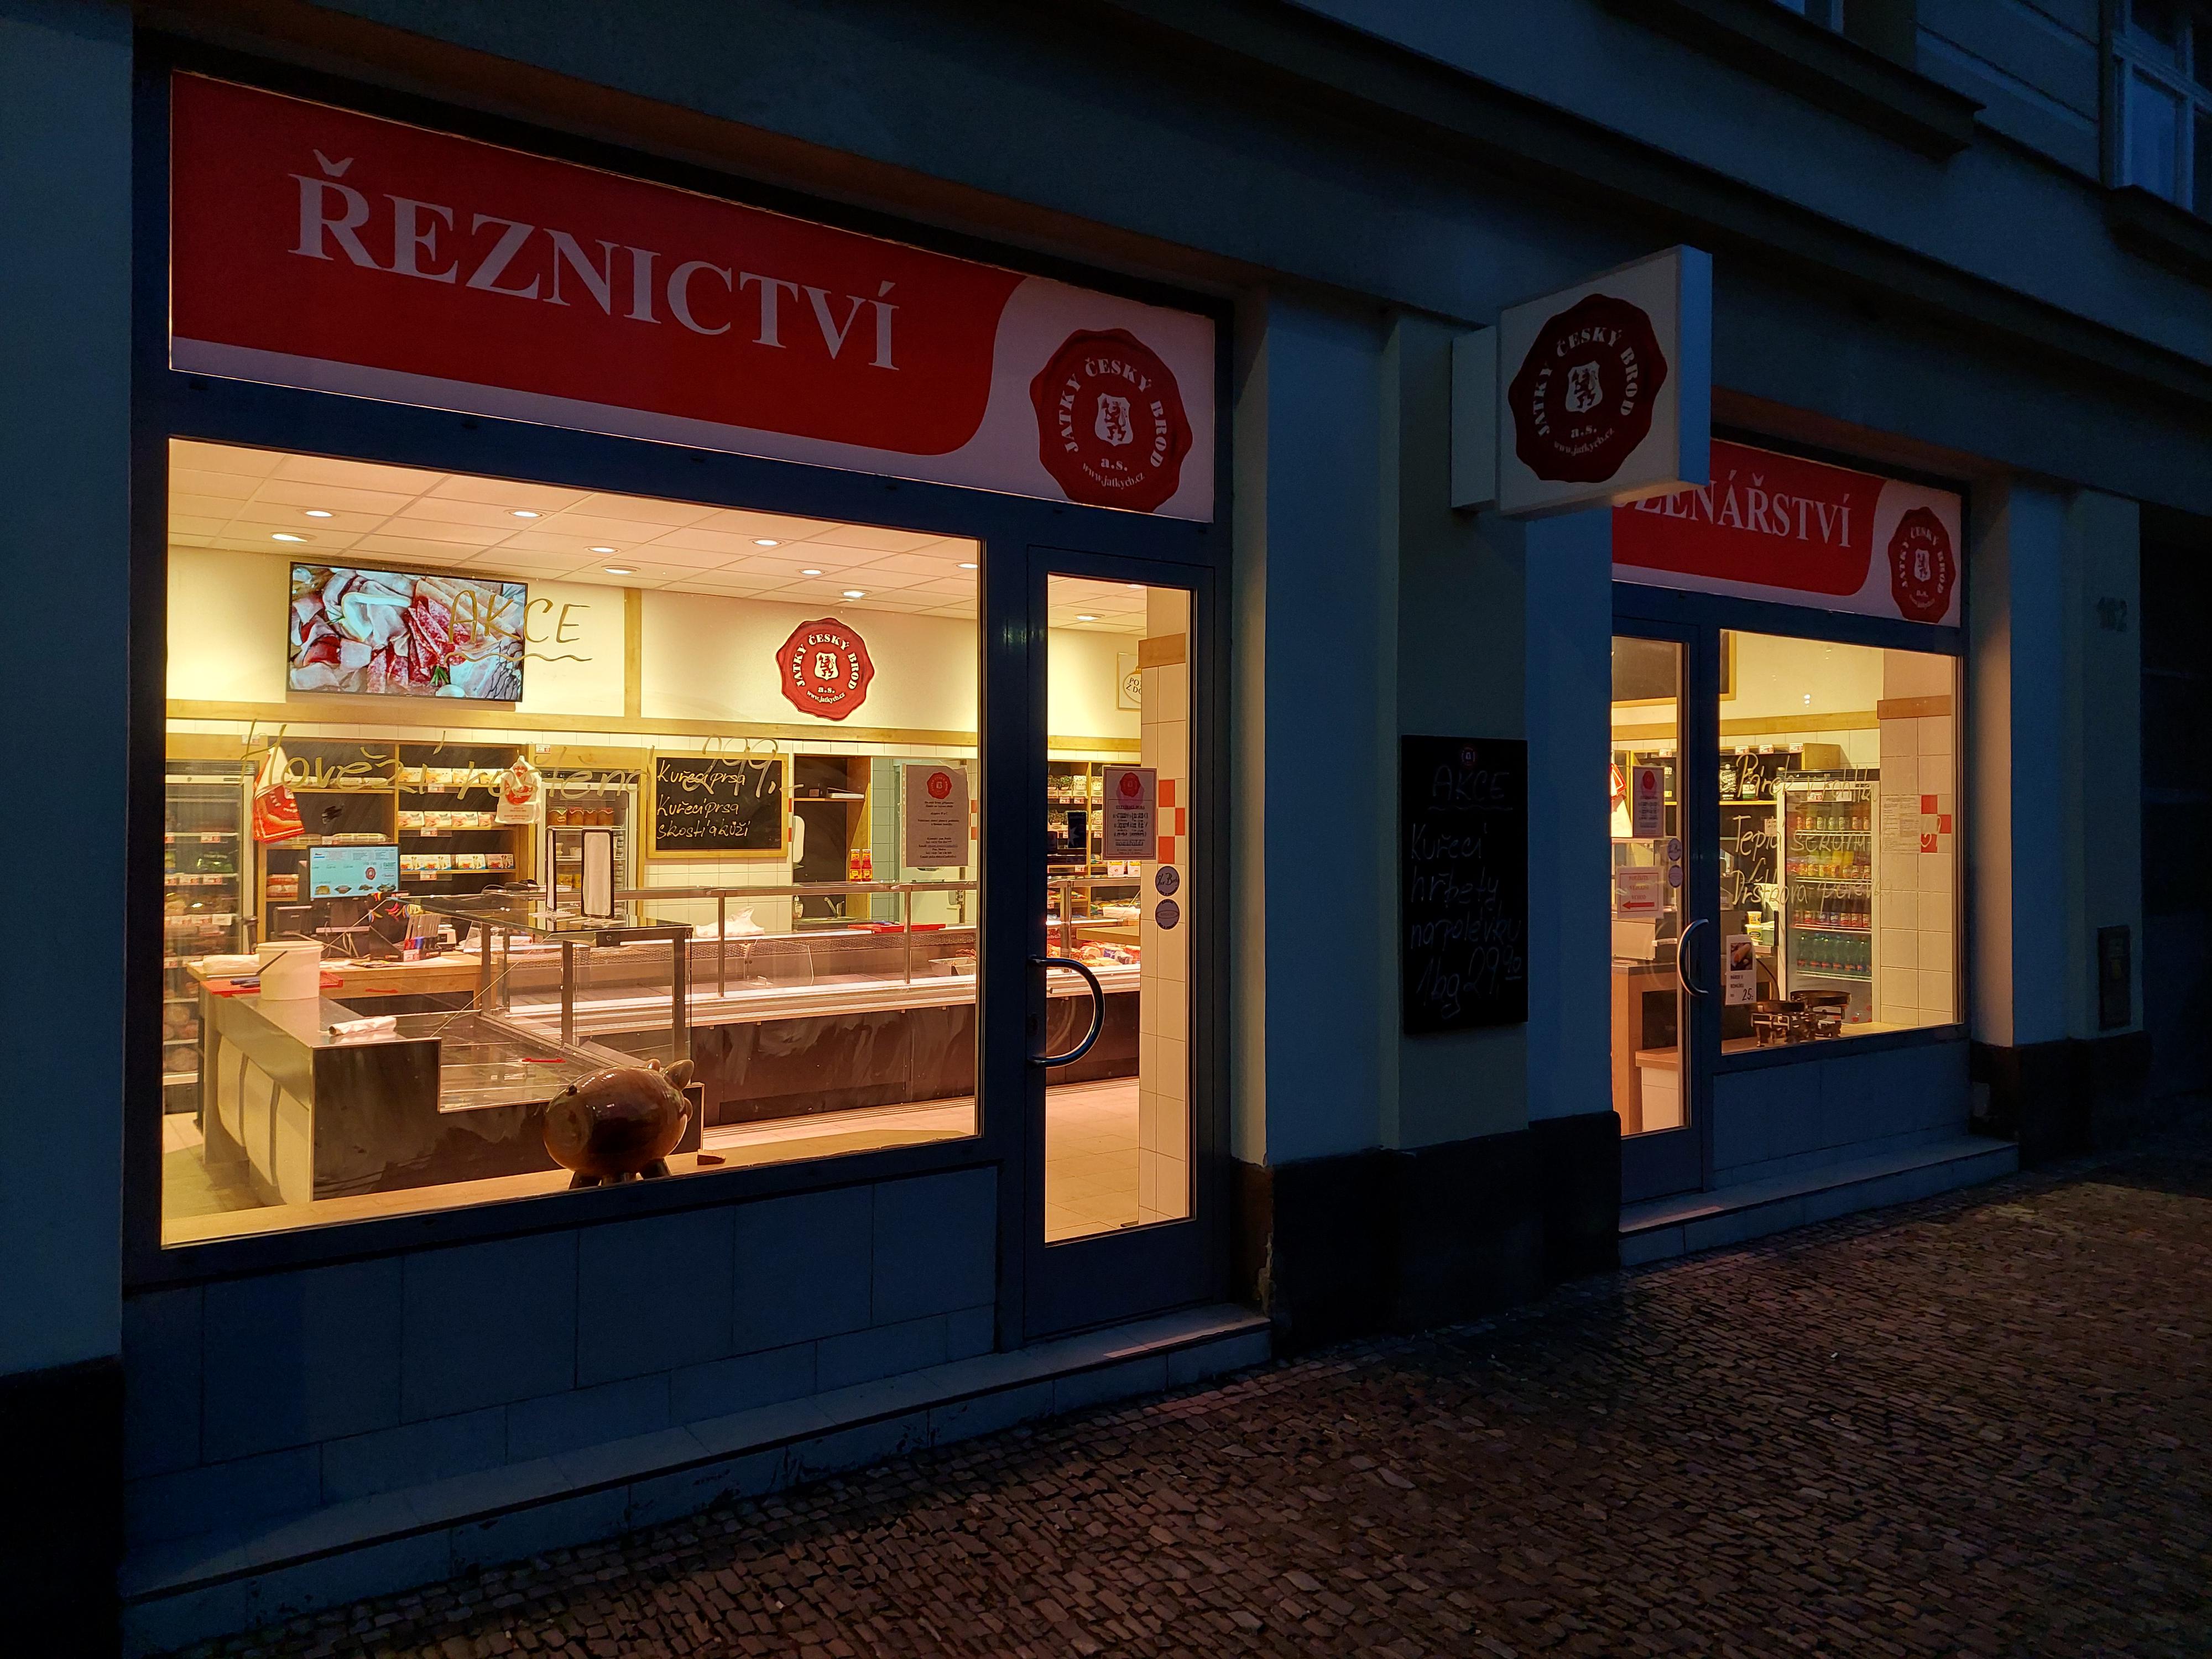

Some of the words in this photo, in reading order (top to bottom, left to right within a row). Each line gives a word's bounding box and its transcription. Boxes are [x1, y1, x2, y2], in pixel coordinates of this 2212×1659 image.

[288, 149, 900, 371] ŘEZNICTVÍ
[1058, 373, 1081, 453] JATKY
[1084, 357, 1152, 393] ČESKÝ
[1150, 400, 1167, 467] BROD
[1100, 457, 1128, 472] a.s.
[1613, 469, 1851, 548] ENÁŘSTVÍ
[448, 589, 591, 644] AKCE
[792, 644, 807, 687] JATKY
[808, 634, 850, 650] ČESKÝ
[847, 652, 859, 690] BROD
[1129, 677, 1141, 686] PO
[1432, 764, 1510, 801] AKCE
